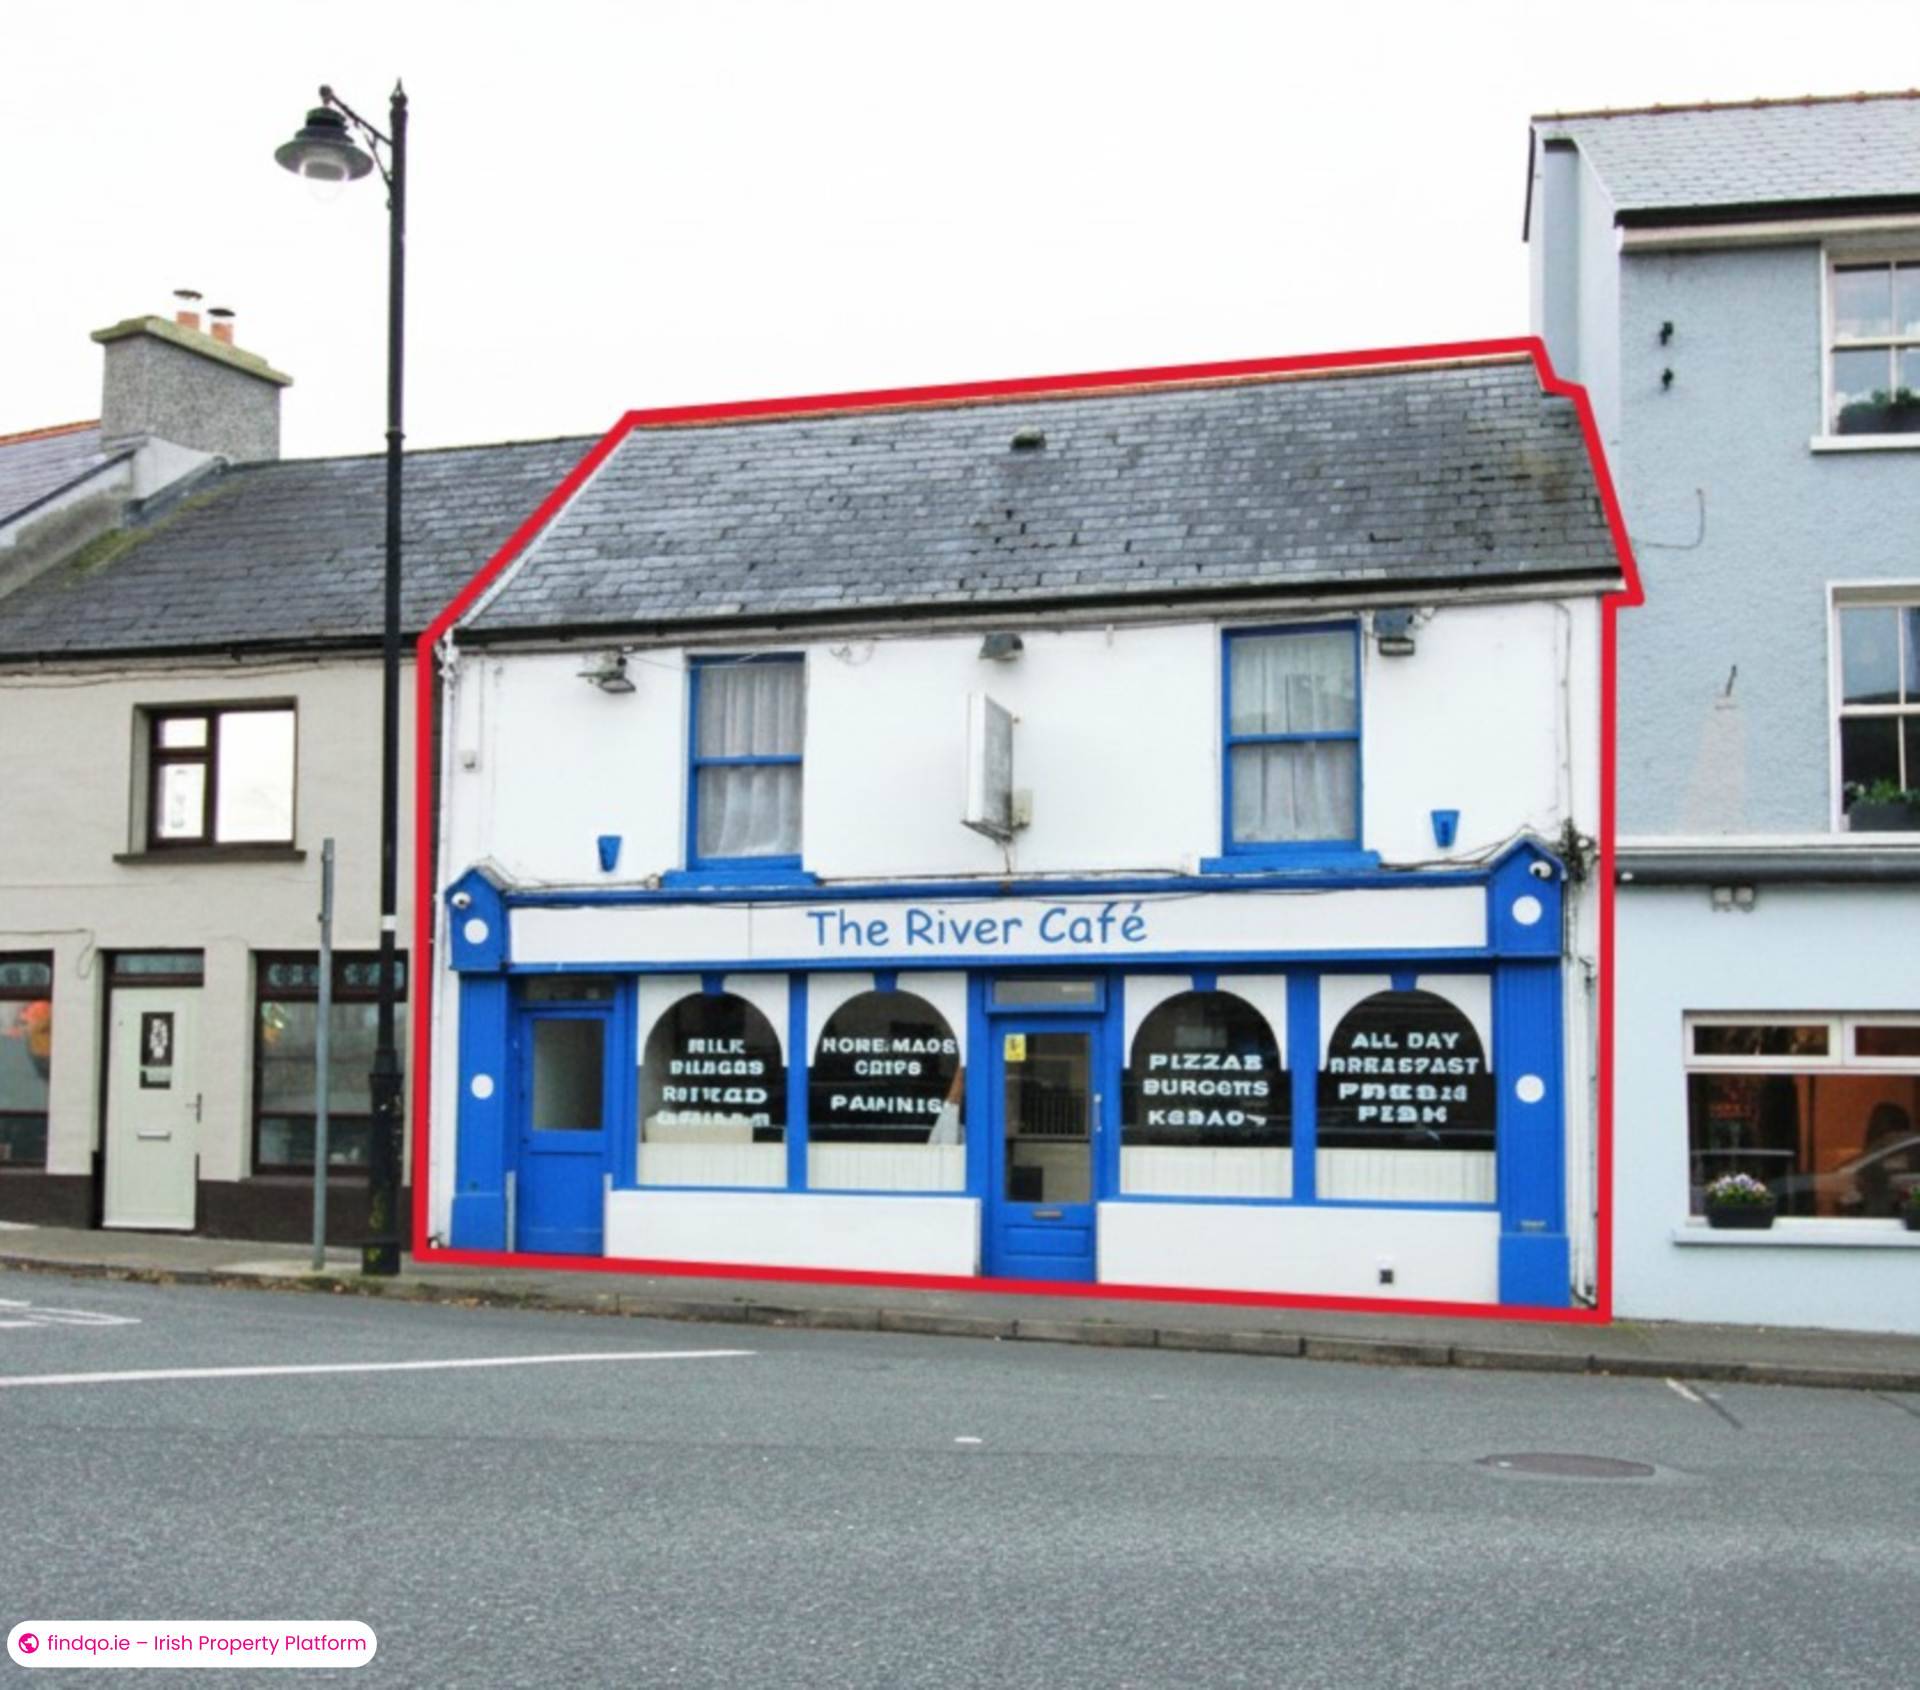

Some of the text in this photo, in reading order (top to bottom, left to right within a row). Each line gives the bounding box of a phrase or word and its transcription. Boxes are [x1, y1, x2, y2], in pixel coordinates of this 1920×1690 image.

[807, 902, 1148, 947] The River Café
[1351, 1032, 1459, 1049] ALL DAY
